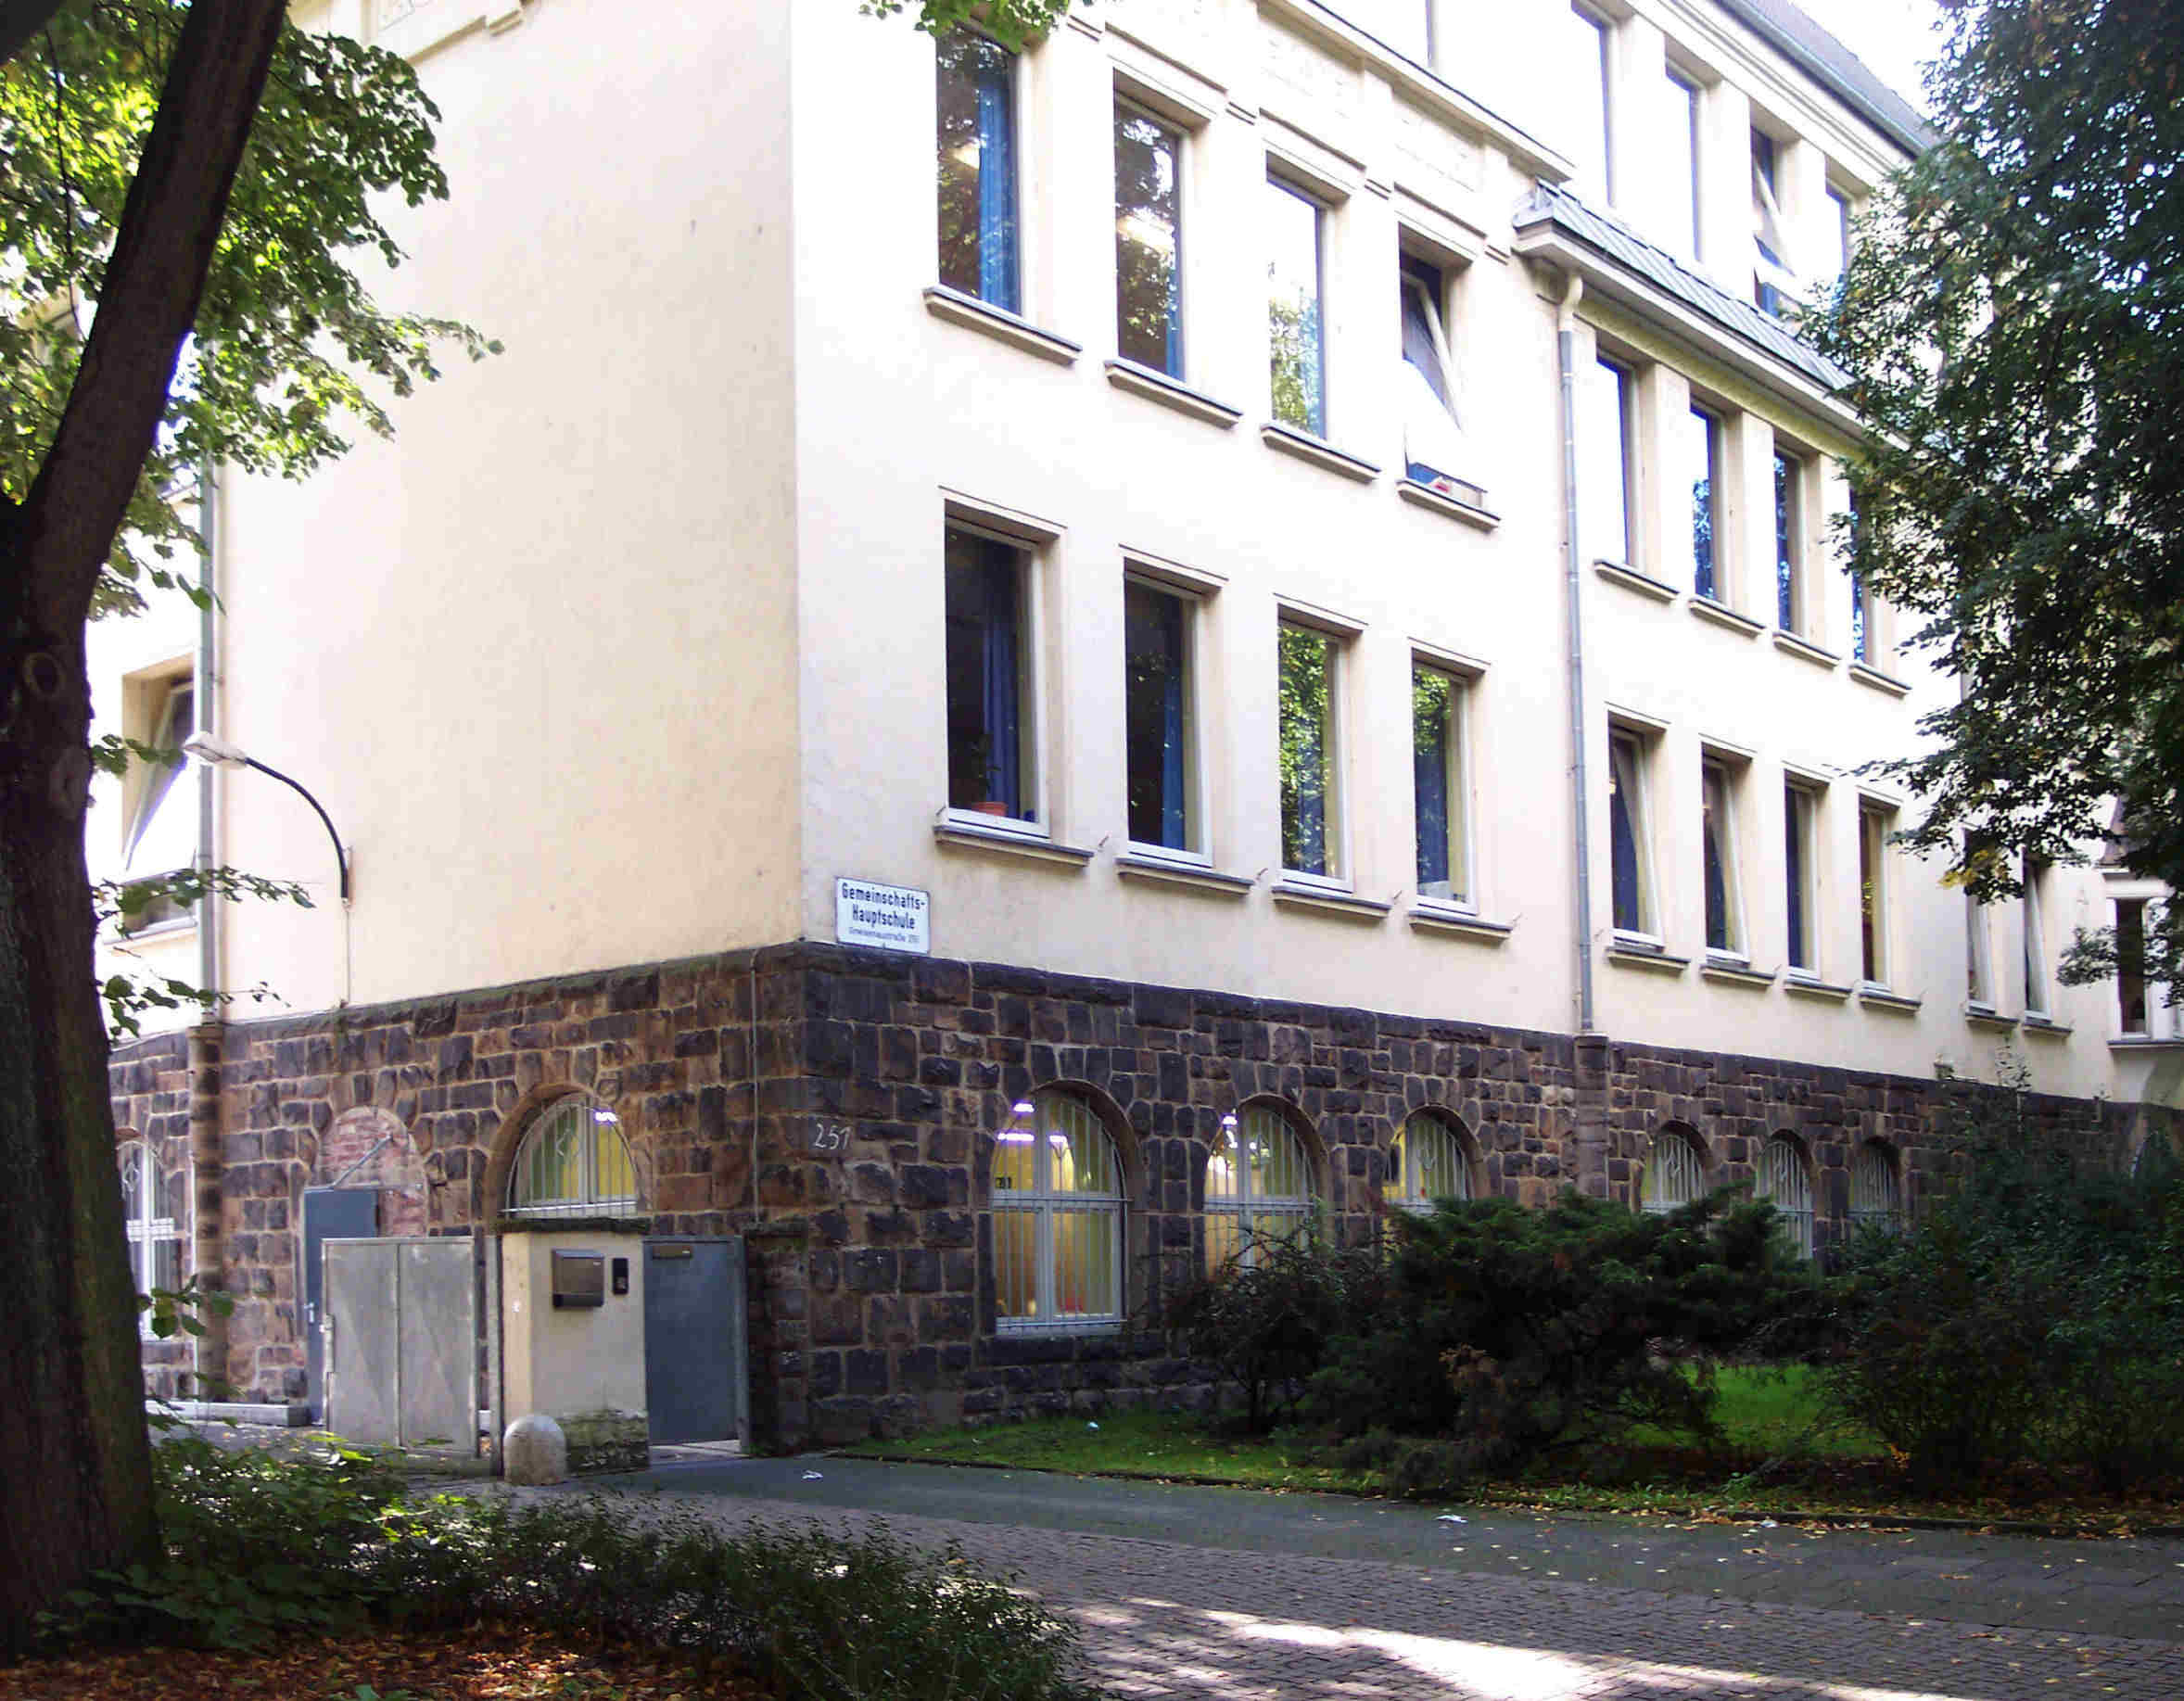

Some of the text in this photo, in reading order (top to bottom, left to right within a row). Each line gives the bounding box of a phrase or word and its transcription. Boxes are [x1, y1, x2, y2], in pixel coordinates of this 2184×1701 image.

[842, 882, 925, 909] Gemeinschafts-
[852, 904, 915, 929] Hauptschule
[812, 1123, 852, 1149] 251
